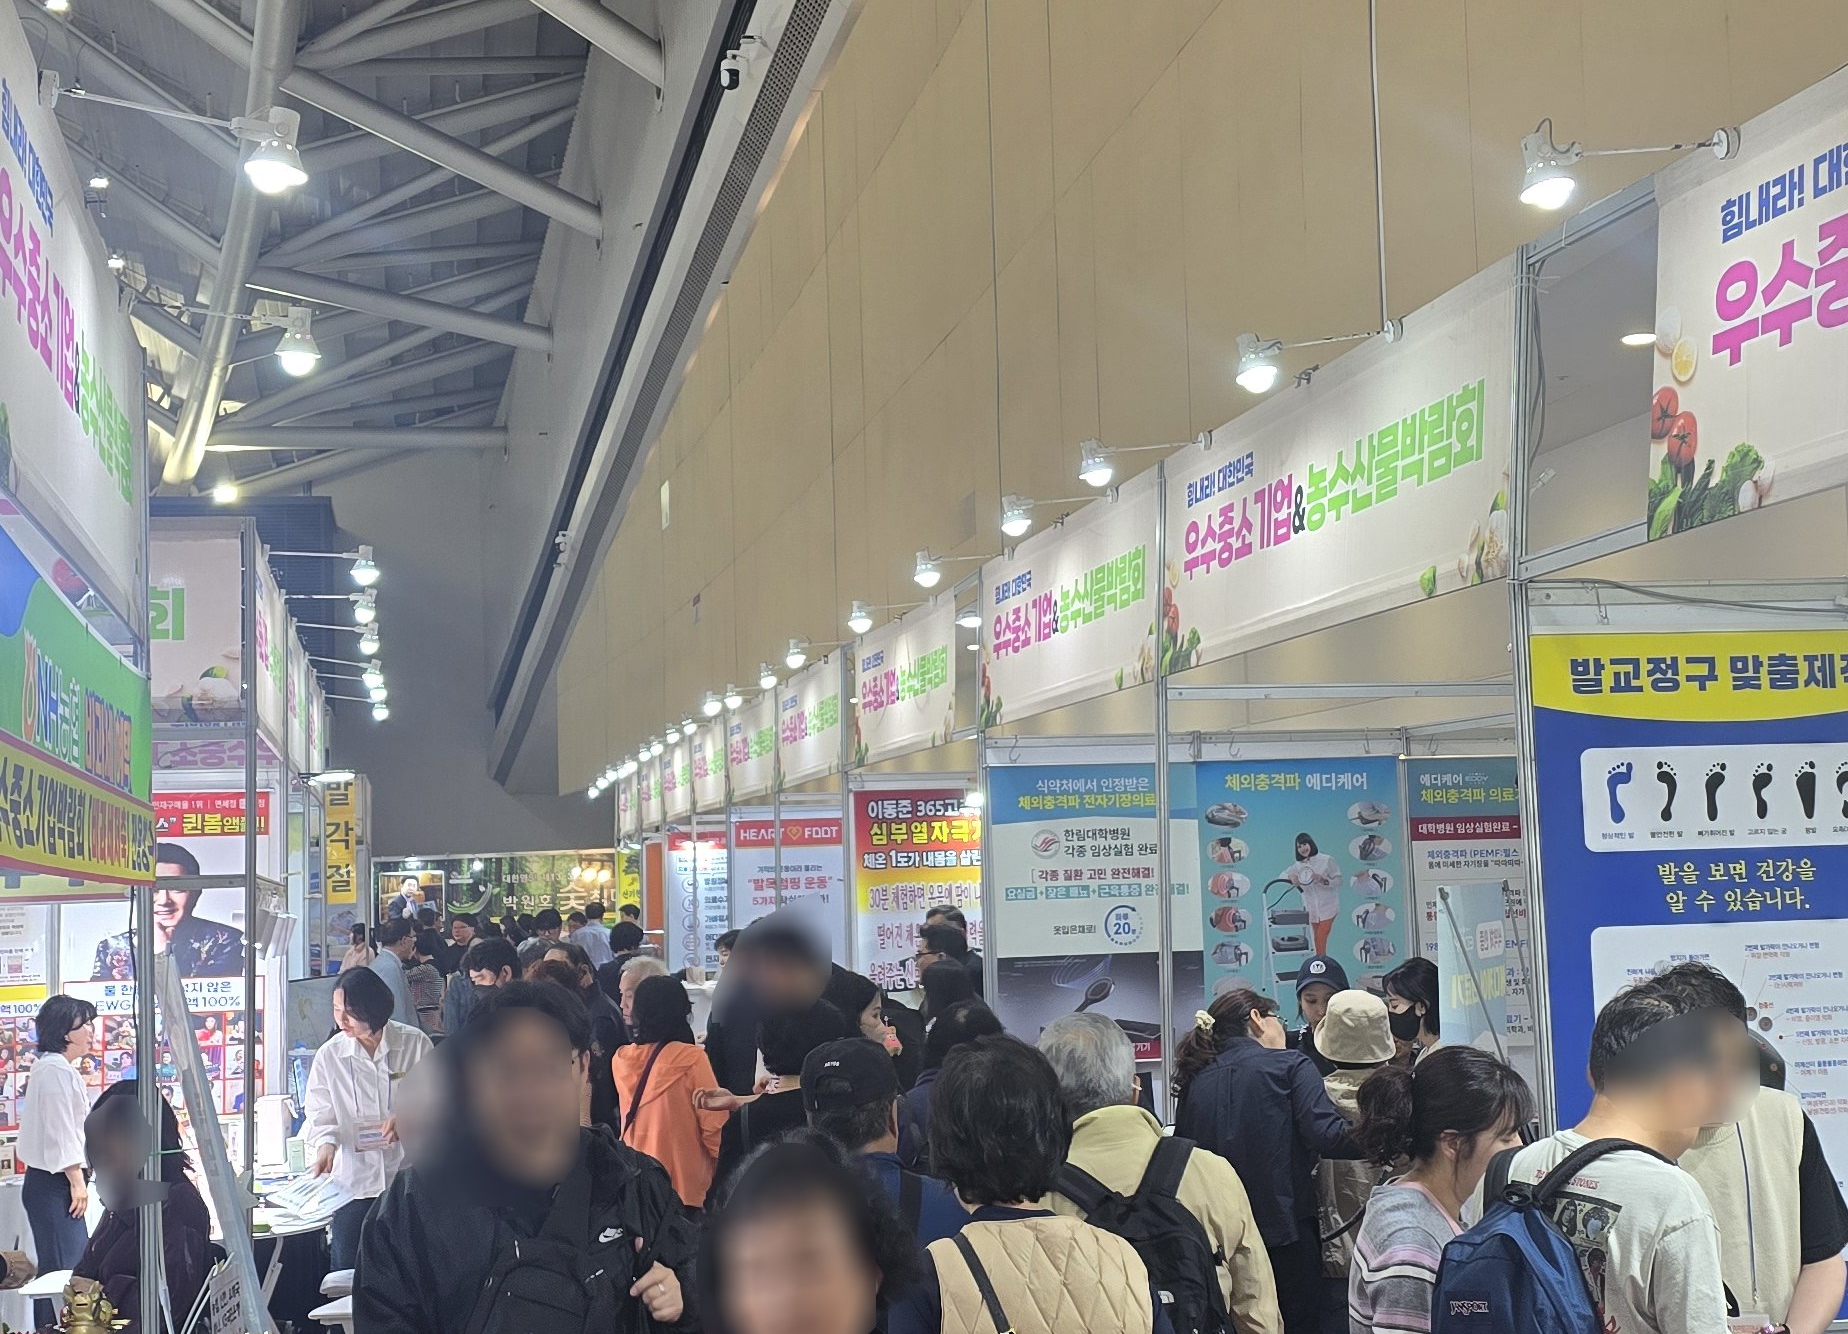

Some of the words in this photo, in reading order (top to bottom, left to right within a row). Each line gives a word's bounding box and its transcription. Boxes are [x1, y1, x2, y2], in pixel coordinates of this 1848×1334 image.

[1721, 164, 1804, 244] 힘내라!
[1813, 142, 1848, 199] 대
[1187, 475, 1216, 508] 힘내라!
[1217, 451, 1254, 493] 대한민국
[1570, 656, 1718, 695] 발교정구
[1729, 653, 1848, 691] 맞춤제
[1036, 779, 1097, 793] 식약처에서
[1101, 778, 1150, 792] 인정받은
[1225, 773, 1300, 792] 체외충격파
[1306, 772, 1368, 790] 에디케어
[1420, 773, 1462, 787] 에디케어
[1018, 795, 1080, 810] 체외충격파
[1083, 793, 1157, 809] 전자기장의료
[1421, 787, 1486, 804] 체외충격파
[868, 799, 912, 818] 이동준
[917, 798, 982, 817] 365고
[1063, 827, 1130, 842] 한림대학병원
[1418, 822, 1454, 834] 대학병원
[1456, 822, 1511, 834] 임상실험완료
[1064, 845, 1087, 857] 각종
[1090, 843, 1134, 857] 임상실험
[1137, 842, 1158, 856] 완료
[863, 853, 887, 868] 체온
[889, 850, 920, 868] 1도가
[922, 850, 957, 867] 내몸을
[1038, 870, 1059, 882] 각종
[1063, 869, 1083, 881] 질환
[1087, 868, 1107, 880] 고민
[1110, 867, 1155, 880] 완전해결!
[1657, 861, 1700, 885] 발을
[1708, 859, 1748, 883] 보면
[1757, 858, 1817, 882] 건강을
[870, 887, 889, 910] 30분
[892, 885, 925, 910] 체험하면
[1145, 883, 1189, 896] 완결!
[1666, 892, 1687, 913] 알
[1694, 890, 1715, 912] 수
[1724, 886, 1810, 911] 있습니다.
[202, 995, 241, 1008] 100%
